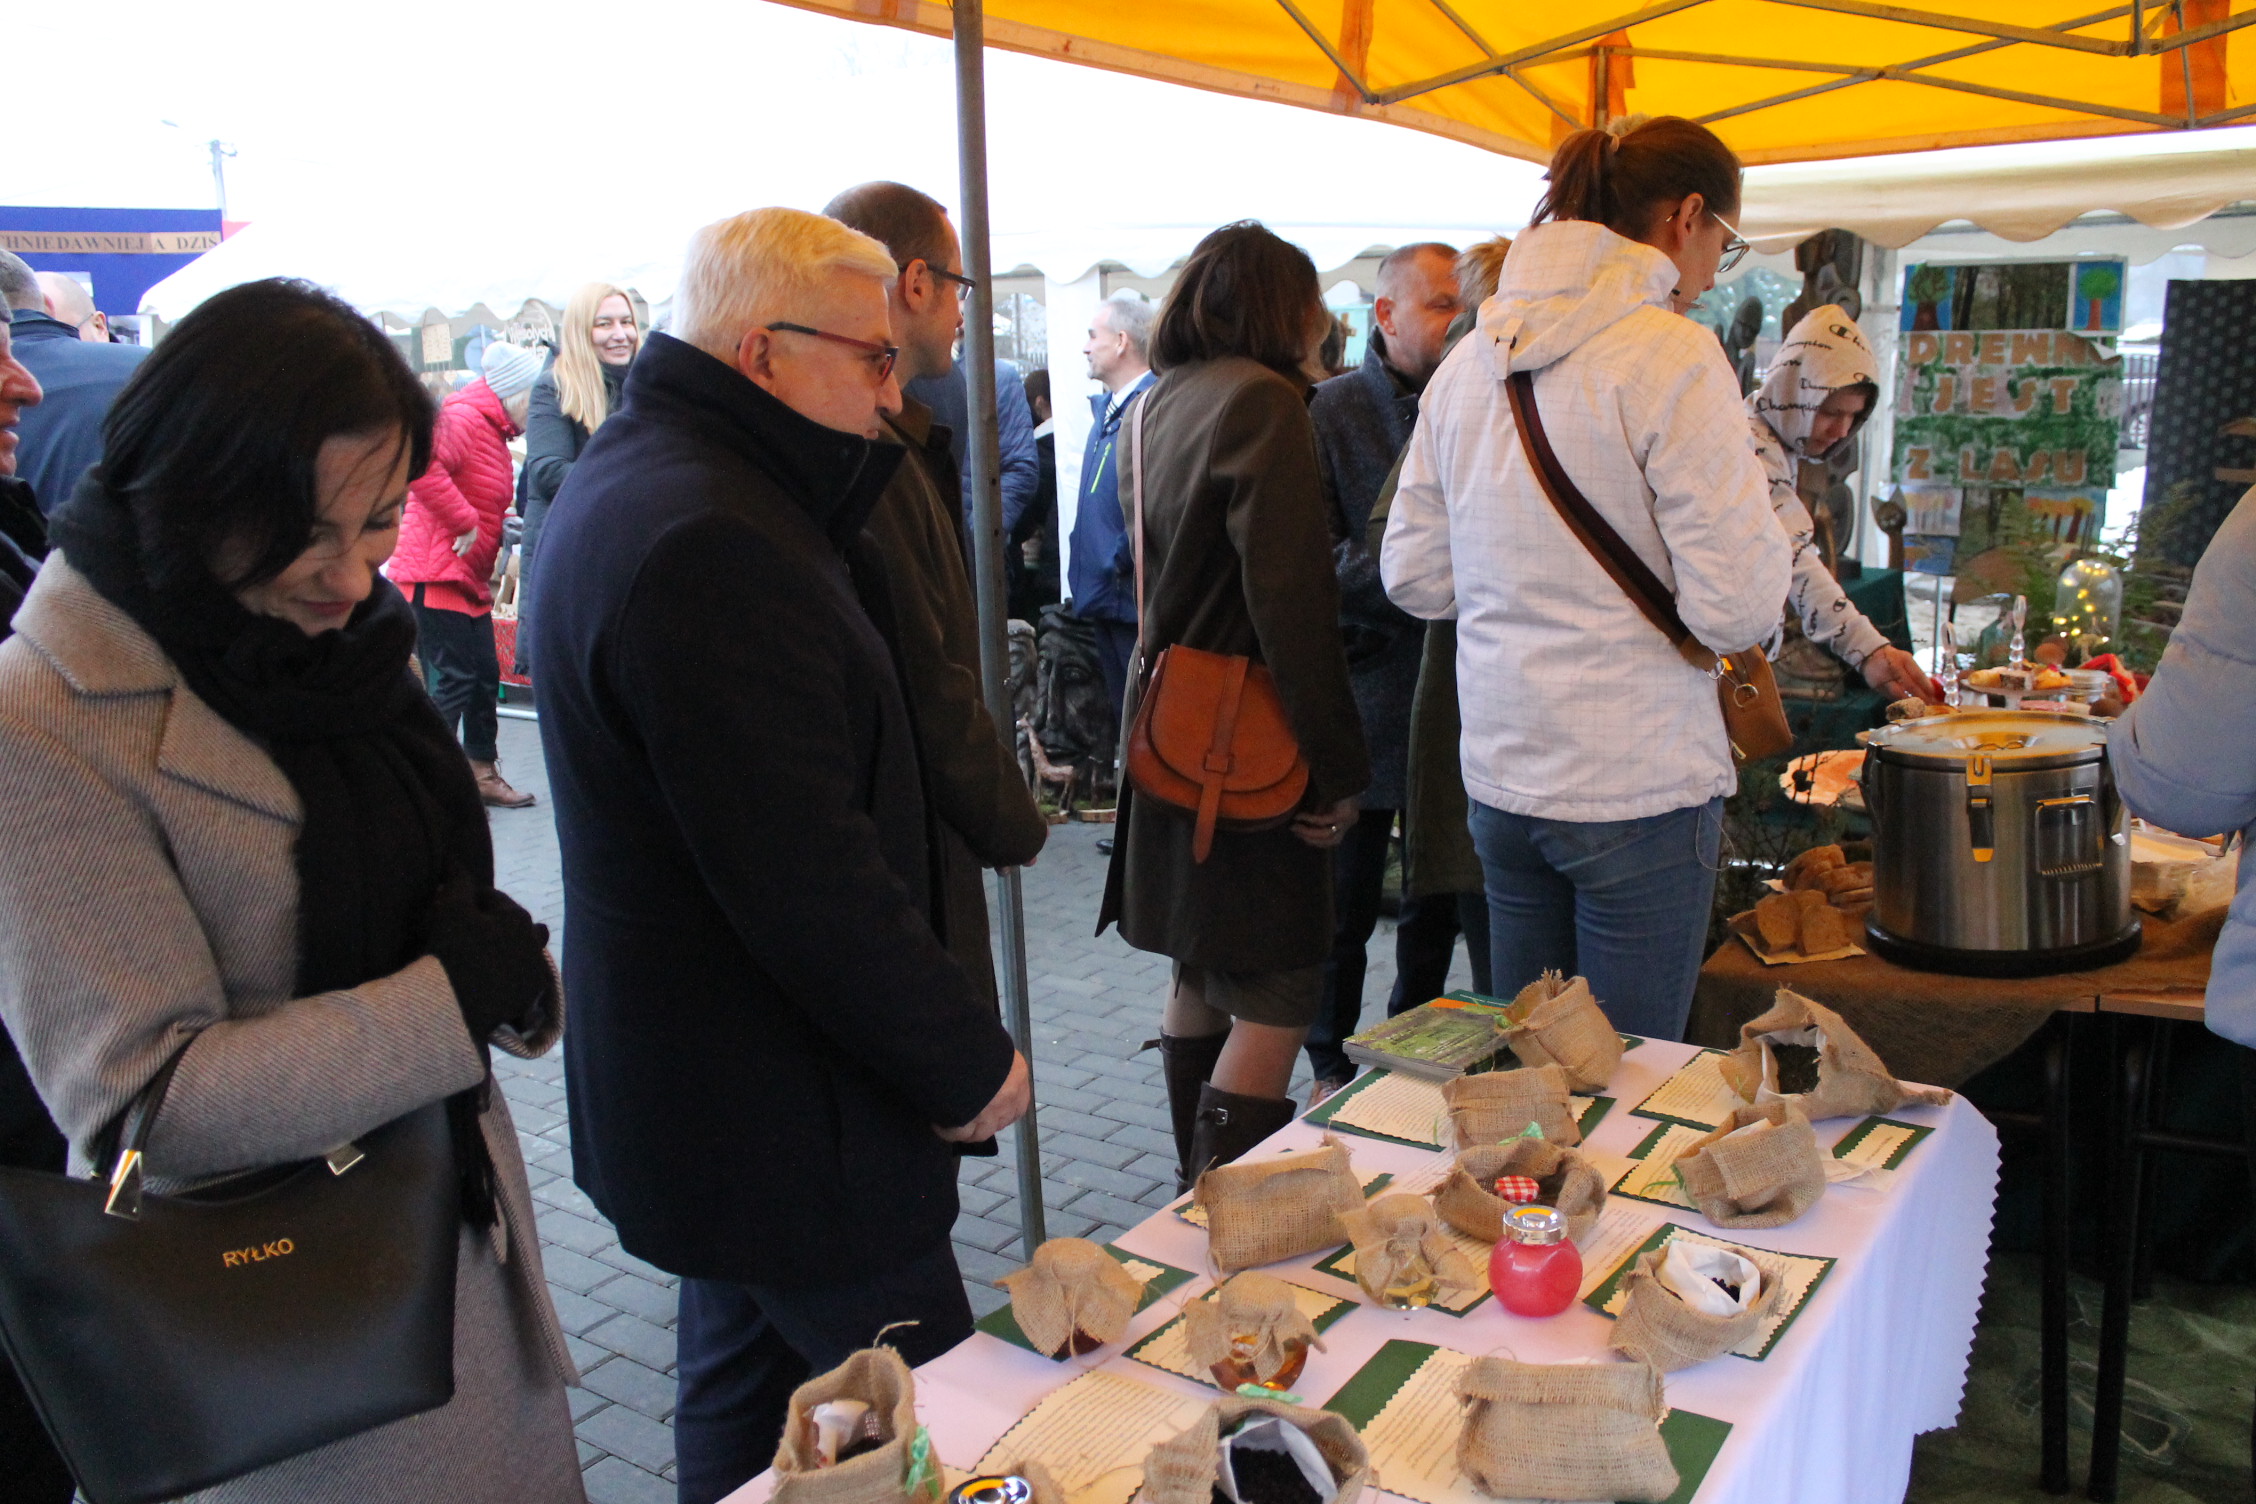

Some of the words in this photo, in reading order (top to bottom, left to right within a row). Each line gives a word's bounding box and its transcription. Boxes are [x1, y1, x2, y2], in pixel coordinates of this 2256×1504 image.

[154, 236, 166, 250] A
[176, 232, 218, 250] DZIŚ
[1908, 332, 2122, 366] DREWN
[1932, 375, 2079, 413] JEST
[1907, 448, 1931, 480] Z
[1961, 448, 2086, 484] LASU
[222, 1238, 294, 1268] RYŁKO
